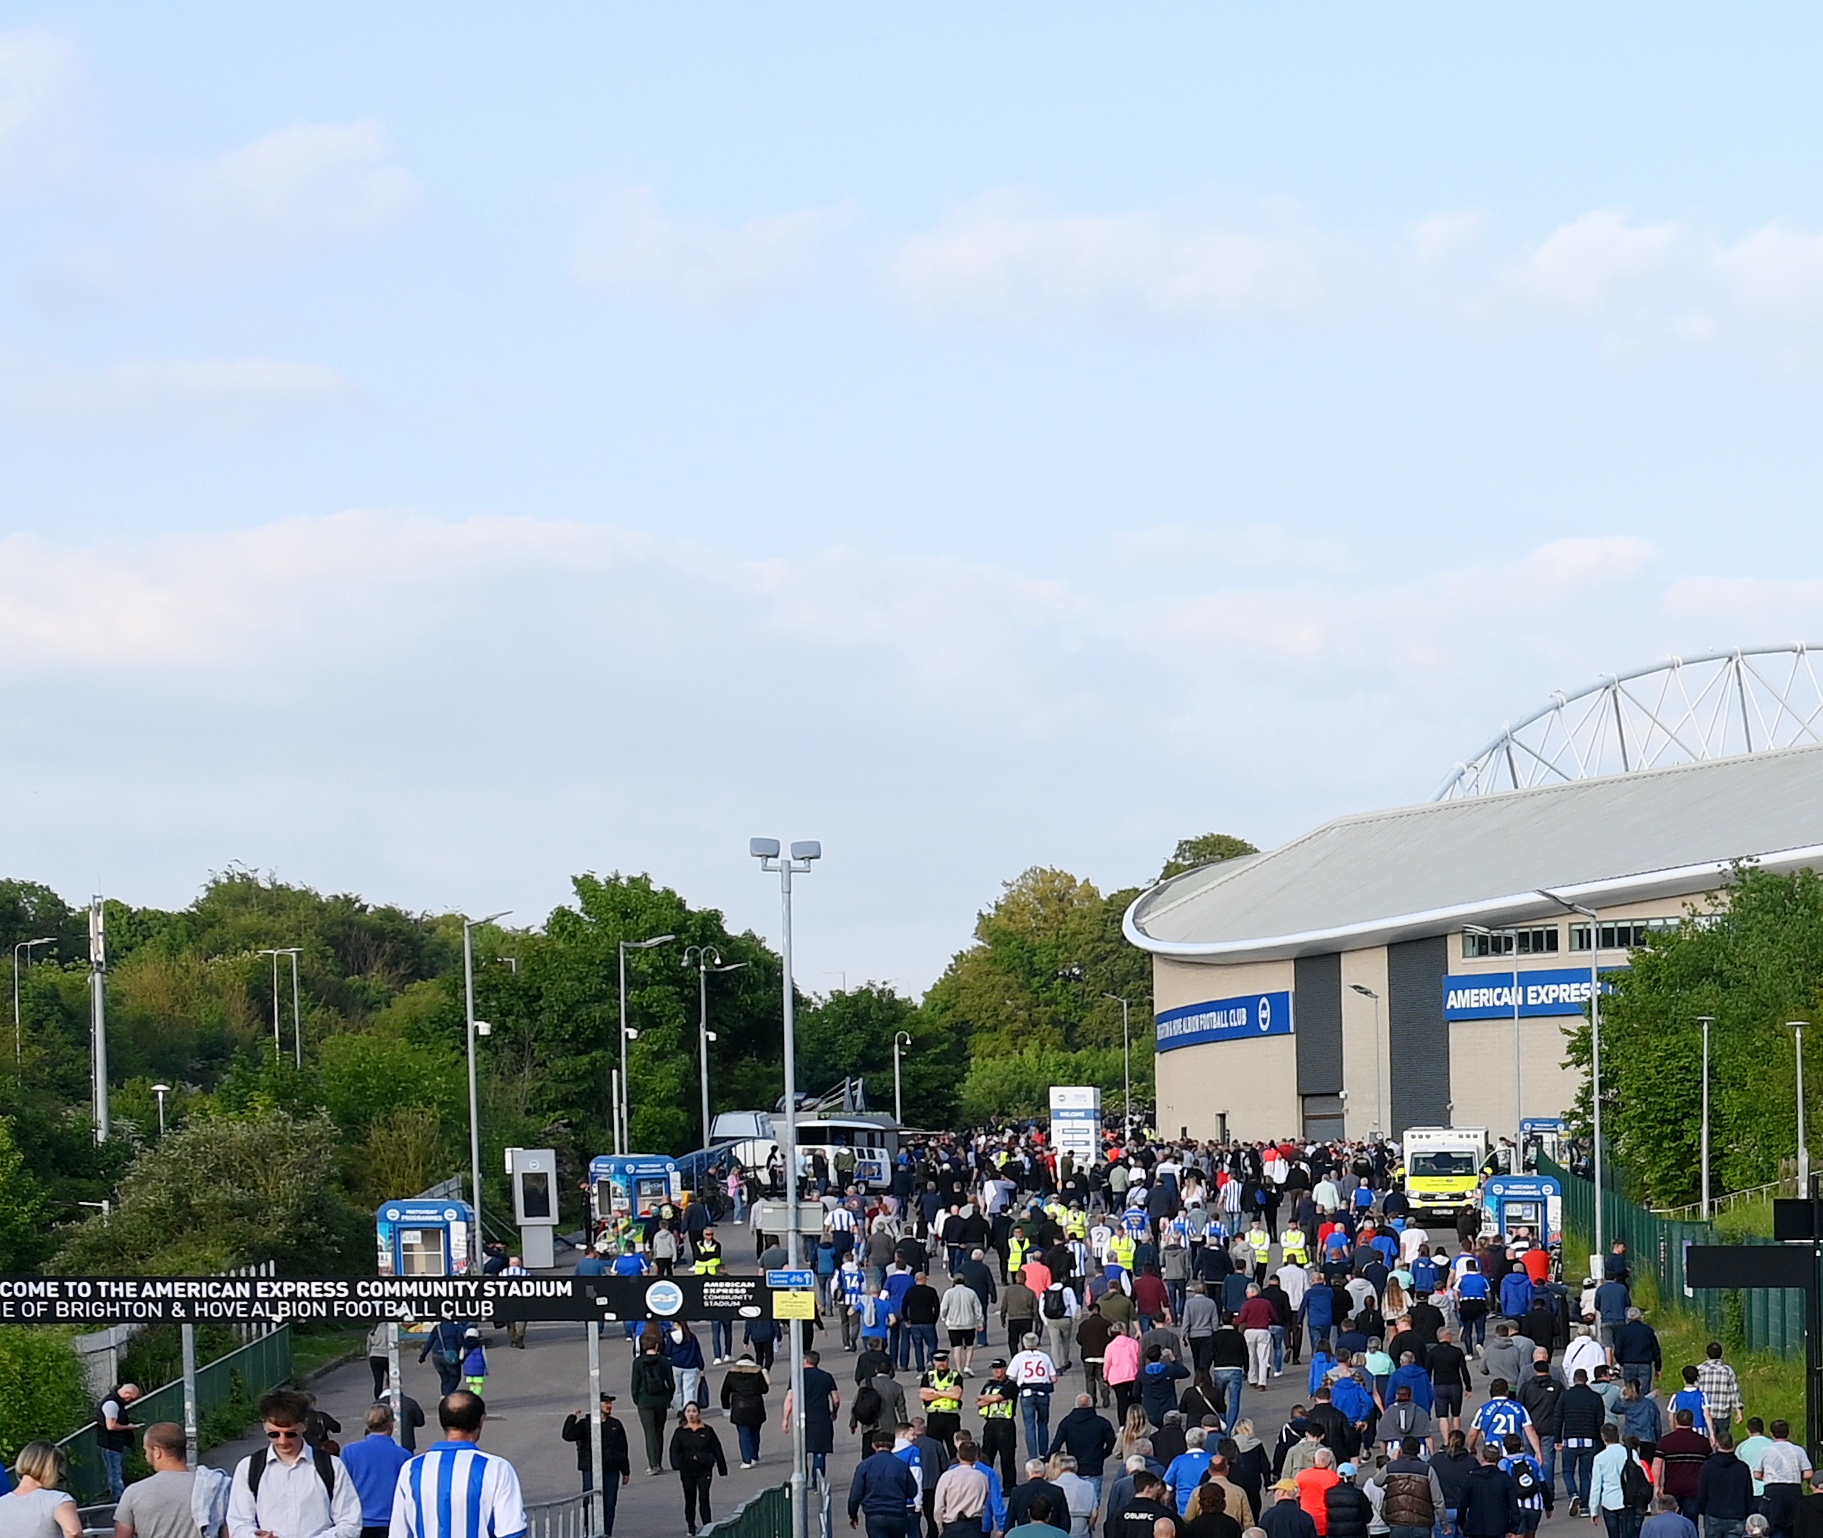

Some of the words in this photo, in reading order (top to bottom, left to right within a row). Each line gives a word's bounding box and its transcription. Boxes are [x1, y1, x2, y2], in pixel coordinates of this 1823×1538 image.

[1446, 987, 1523, 1009] AMERICAN
[1229, 1007, 1247, 1027] CLUB
[0, 1281, 60, 1298] COME
[64, 1281, 92, 1298] TO
[96, 1281, 138, 1298] THE
[141, 1281, 250, 1298] AMERICAN
[256, 1281, 349, 1298] EXPRESS
[356, 1281, 479, 1298] COMMUNITY
[483, 1281, 573, 1297] STADIUM
[845, 1275, 859, 1289] 14
[21, 1301, 49, 1318] OF
[56, 1301, 162, 1318] BRIGHTON
[171, 1301, 187, 1318] &
[194, 1301, 249, 1318] HOVE
[251, 1301, 327, 1318] ALBION
[333, 1301, 437, 1318] FOOTBALL
[440, 1301, 494, 1318] CLUB
[1024, 1360, 1046, 1378] 56
[1492, 1413, 1515, 1435] 21
